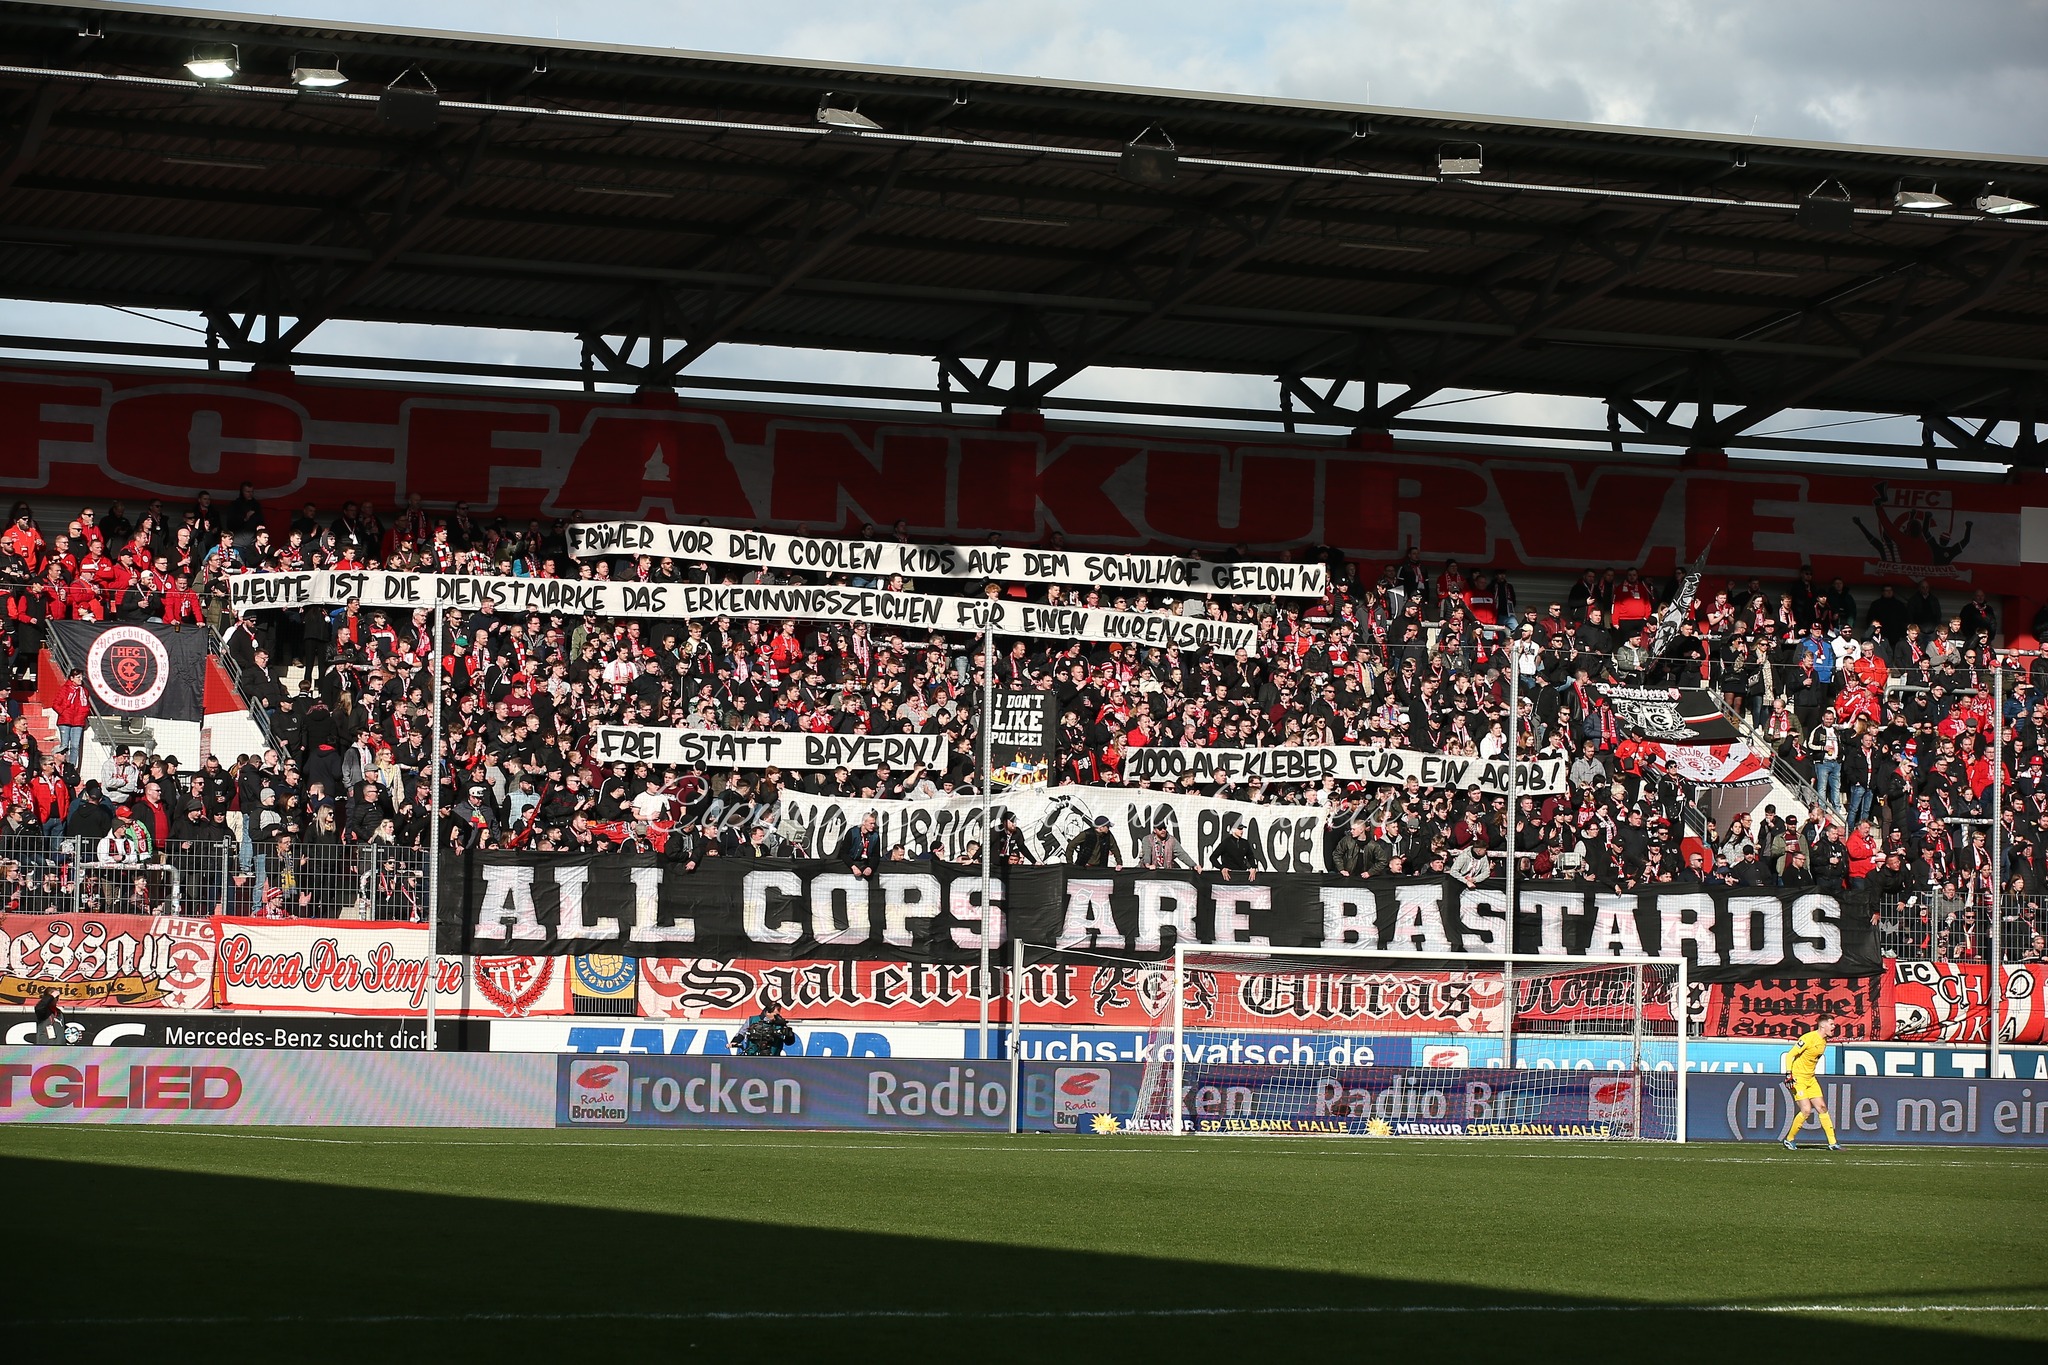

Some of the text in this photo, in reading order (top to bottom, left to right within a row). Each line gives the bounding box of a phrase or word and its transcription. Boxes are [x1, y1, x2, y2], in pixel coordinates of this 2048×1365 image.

[1894, 489, 1942, 507] HFC
[568, 523, 655, 550] FRÜHER
[668, 528, 714, 556] VOR
[729, 533, 776, 562] DEN
[788, 539, 882, 571] COOLEN
[899, 546, 956, 575] KIDS
[968, 549, 1011, 575] AUF
[1023, 552, 1070, 578] DEM
[1084, 556, 1202, 587] SCHULHOF
[1877, 561, 1956, 574] HFC-FANKURVE
[232, 573, 1254, 652] HEUTE IST DIE DIENSTMARKE DAS ERKENNUNGSZEICHEN FÜR EINEN HURENSOHN!
[95, 629, 161, 651] Merseburger
[117, 648, 141, 657] HFC
[111, 695, 147, 708] Jungs
[995, 693, 1045, 709] I DON'T
[992, 709, 1044, 732] LIKE
[600, 729, 945, 770] FREI STATT BAYERN!
[990, 732, 1043, 747] POLIZEI
[1128, 748, 1187, 778] 1000
[1192, 749, 1338, 779] AUFKLEBER
[1349, 747, 1405, 780] FÜR
[1420, 756, 1468, 786] EIN
[1737, 778, 1774, 788] SIEGEN
[473, 864, 697, 943] ALL
[742, 869, 1007, 951] COPS
[1055, 878, 1273, 958] ARE
[1318, 884, 1843, 966] BASTARDS
[166, 920, 215, 939] HFC
[219, 933, 464, 1010] Coesa Per Sempre
[164, 1026, 323, 1048] Mercedes-Benz
[328, 1030, 382, 1049] sucht
[390, 1030, 438, 1050] dich!
[1004, 1031, 1376, 1067] fuchs-kovatsch.de
[0, 1063, 243, 1110] TGLIED
[867, 1066, 1008, 1118] Radio
[580, 1093, 615, 1105] Radio
[1064, 1100, 1097, 1111] Radio
[571, 1105, 626, 1120] Brocken
[1895, 1086, 1978, 1133] mal
[1297, 1120, 1349, 1134] HALLE
[1396, 1123, 1464, 1136] MERKUR
[1466, 1123, 1554, 1136] SPIELBANK
[1558, 1125, 1611, 1137] HALLE
